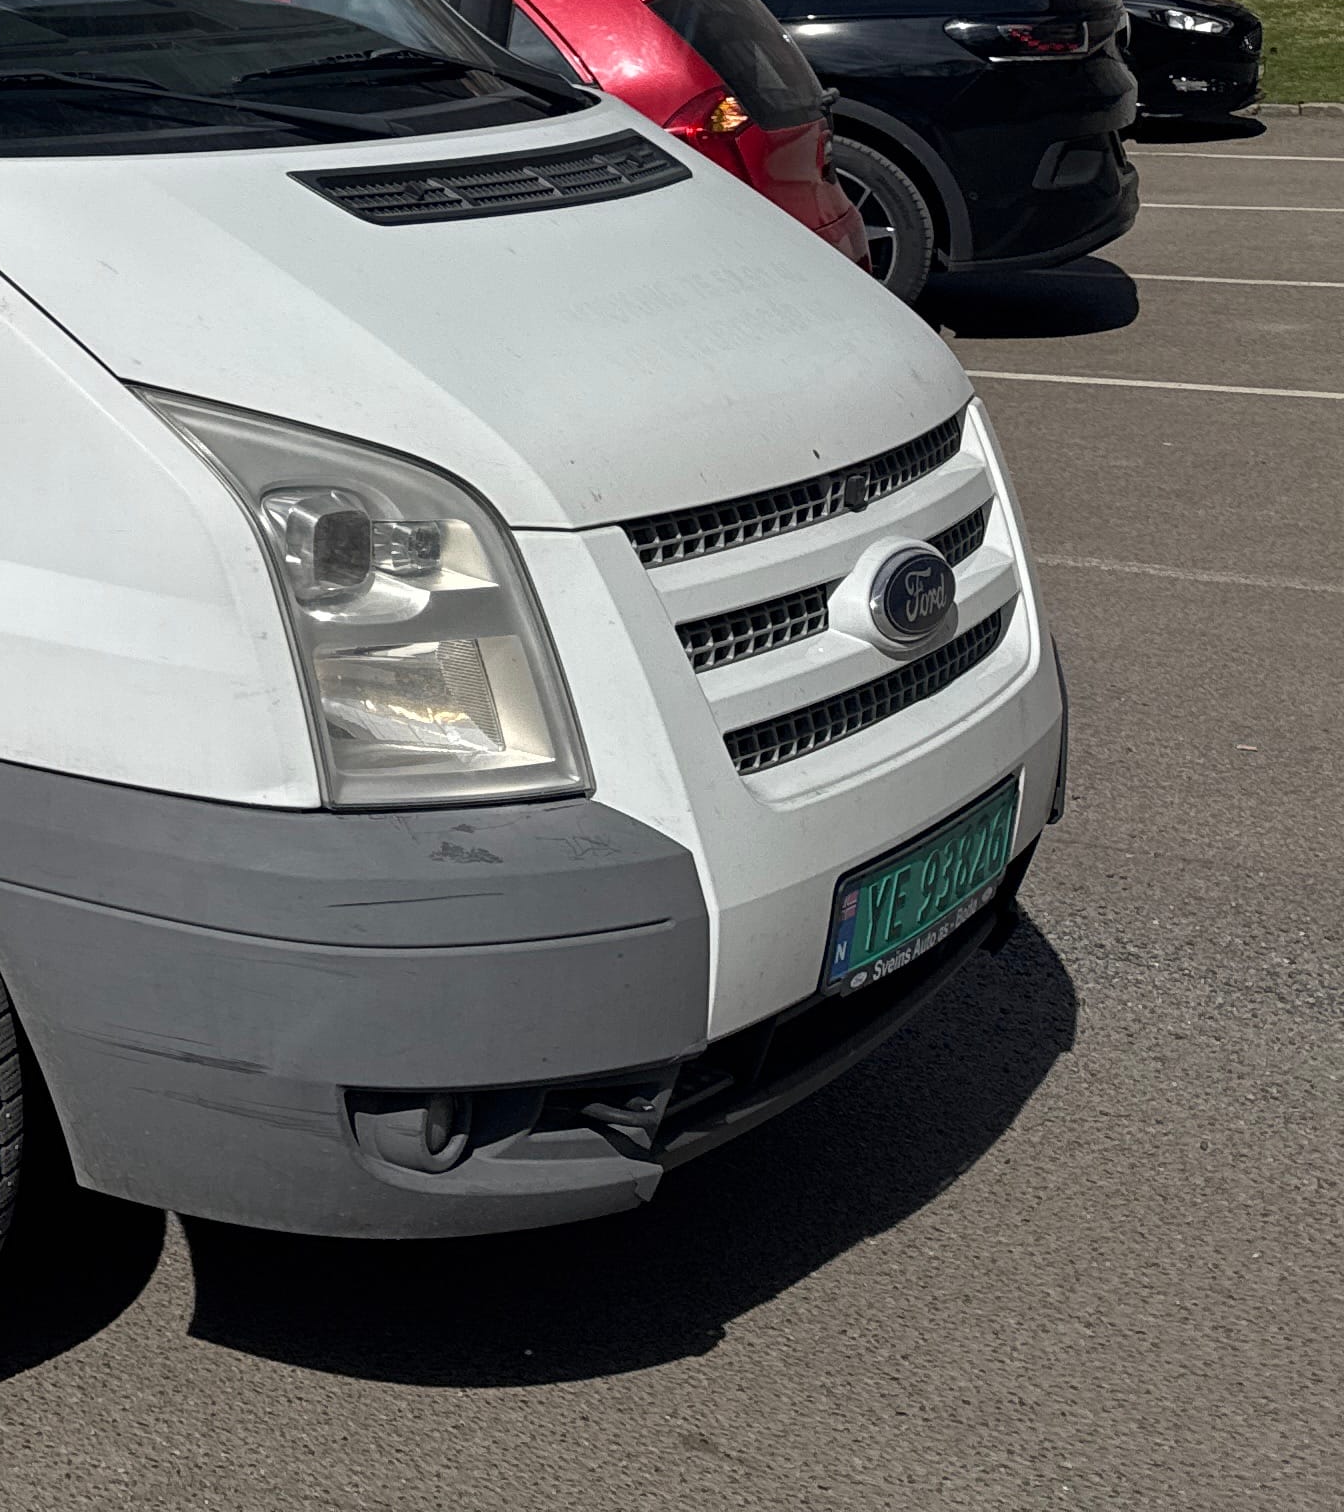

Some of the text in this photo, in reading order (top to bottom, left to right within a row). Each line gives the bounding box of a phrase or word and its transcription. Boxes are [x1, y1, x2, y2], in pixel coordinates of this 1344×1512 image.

[905, 567, 946, 622] Ford
[865, 810, 1004, 953] YE 93826
[834, 941, 847, 965] N
[873, 949, 911, 980] Sveins
[912, 932, 937, 960] Auto
